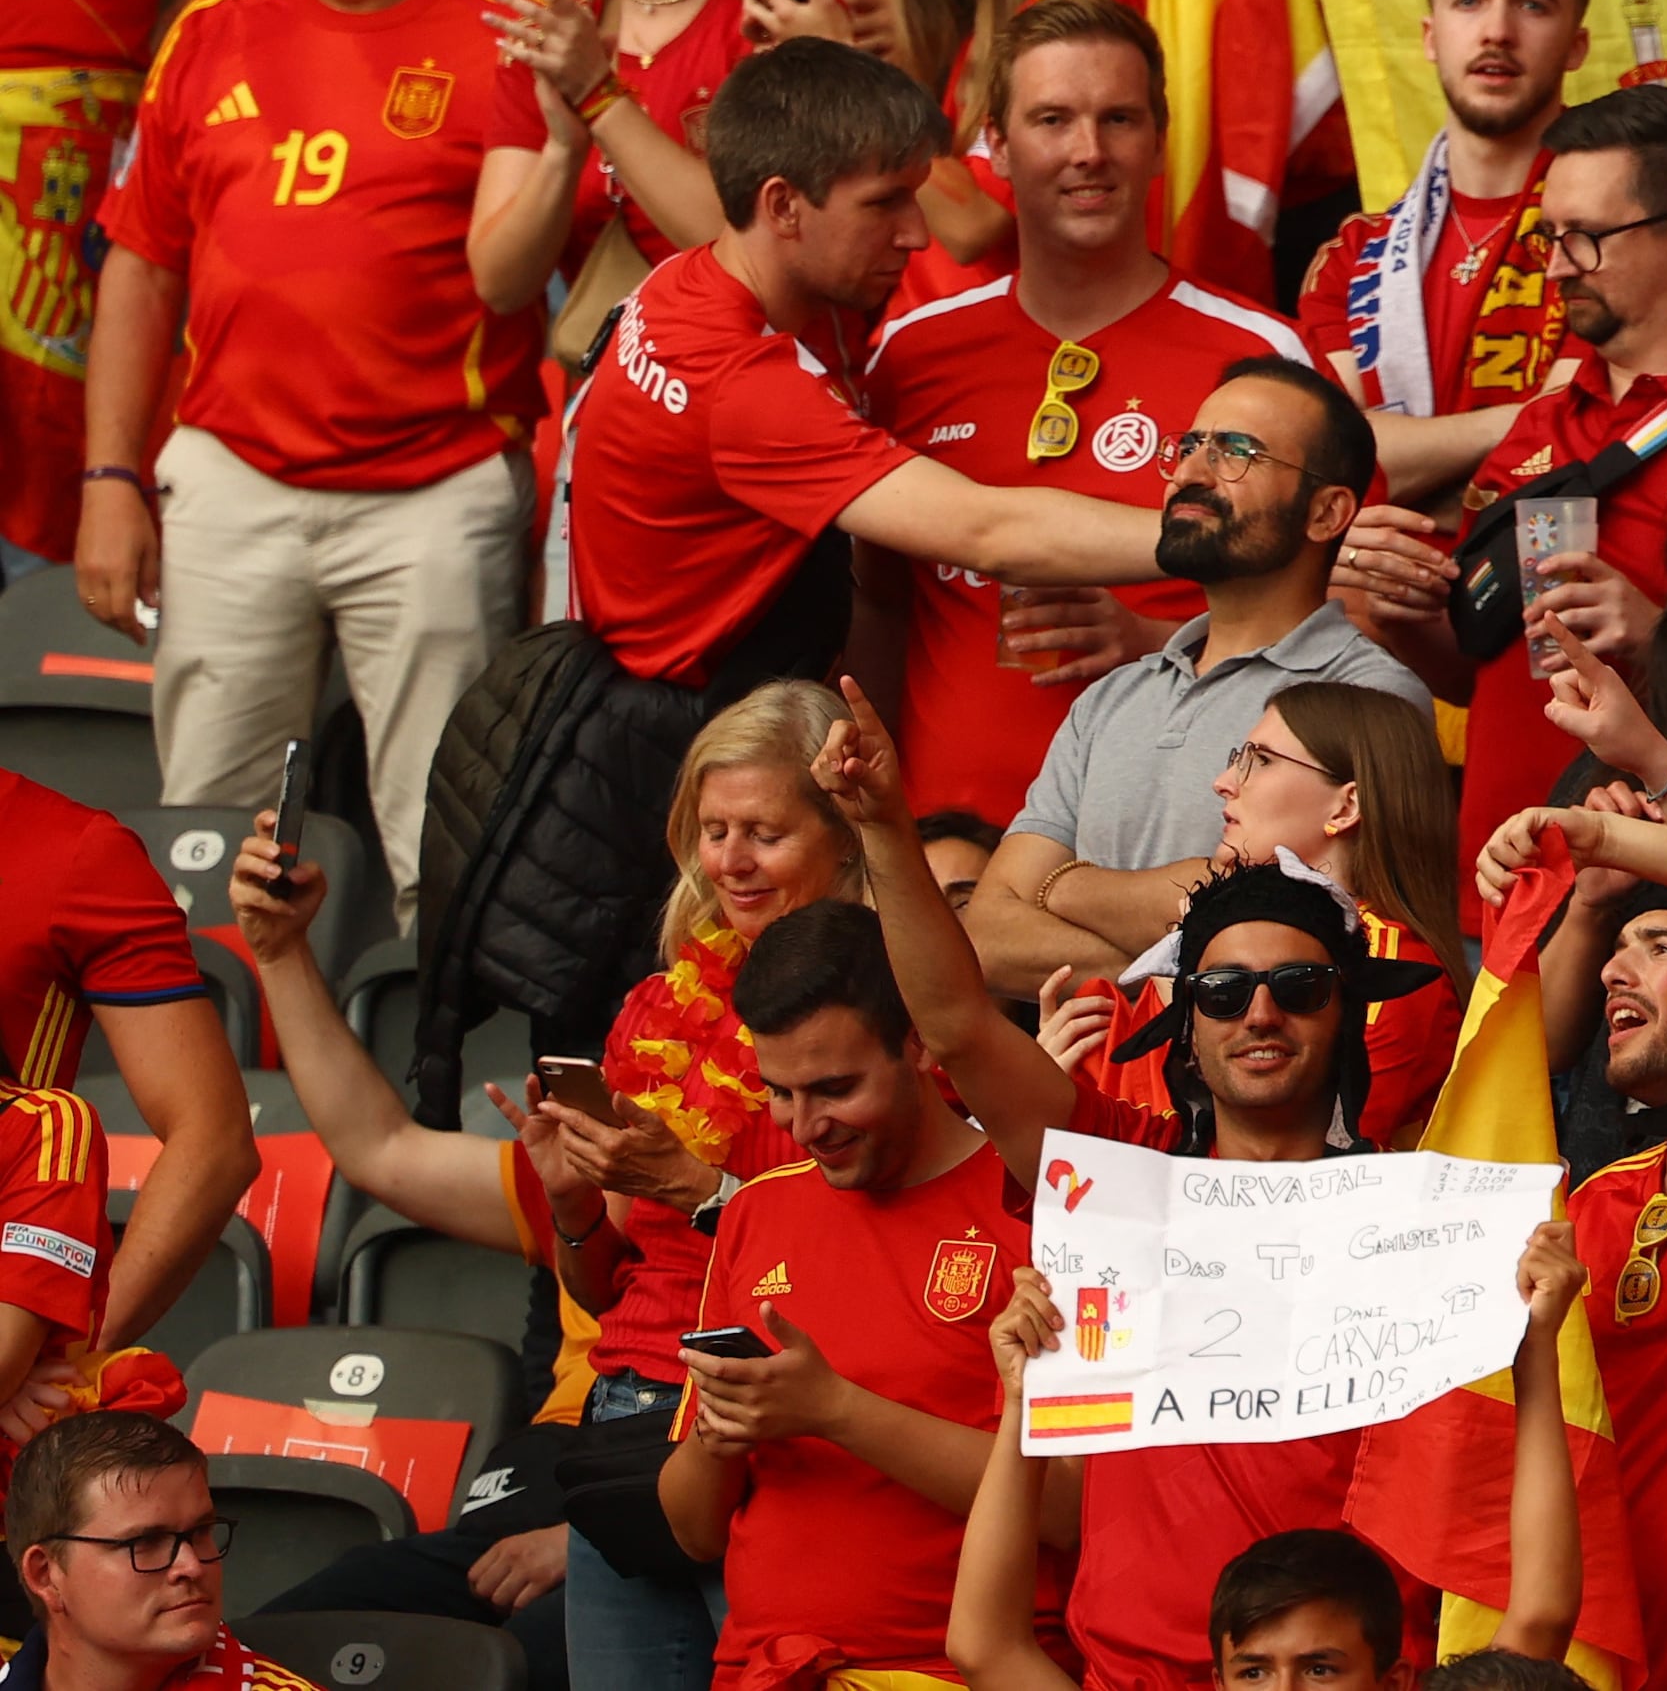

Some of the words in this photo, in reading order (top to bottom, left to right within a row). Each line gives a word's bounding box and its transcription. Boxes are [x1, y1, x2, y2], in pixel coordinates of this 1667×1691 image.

[271, 129, 349, 207] 19
[927, 421, 977, 446] JAKO
[191, 841, 206, 862] 6
[1183, 1164, 1383, 1208] CARVAJAL
[6, 1224, 29, 1233] UEFA
[5, 1231, 93, 1268] FOUNDATION
[751, 1282, 792, 1297] adidas
[1334, 1305, 1389, 1324] DANI
[1187, 1308, 1243, 1359] 2
[1295, 1314, 1459, 1377] CARVAJAL
[347, 1365, 365, 1387] 8
[1150, 1387, 1185, 1426] A
[1209, 1388, 1280, 1423] POR
[1295, 1365, 1408, 1417] ELLOS
[467, 1467, 515, 1499] NIKE
[350, 1652, 366, 1676] 9
